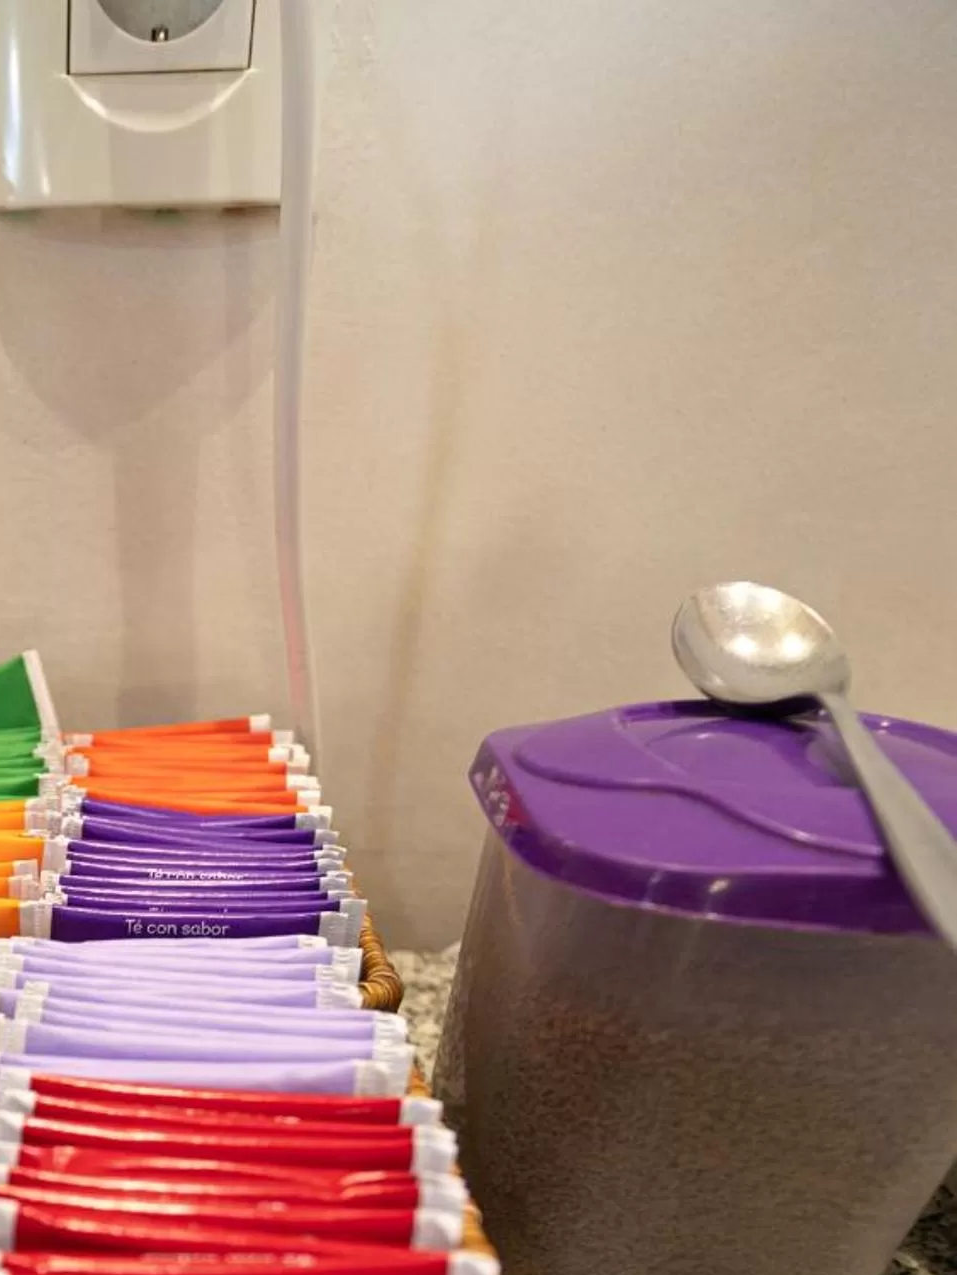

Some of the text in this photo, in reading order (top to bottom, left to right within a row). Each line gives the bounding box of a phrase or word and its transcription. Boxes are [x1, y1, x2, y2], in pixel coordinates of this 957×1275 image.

[125, 918, 231, 936] Té con sabor
